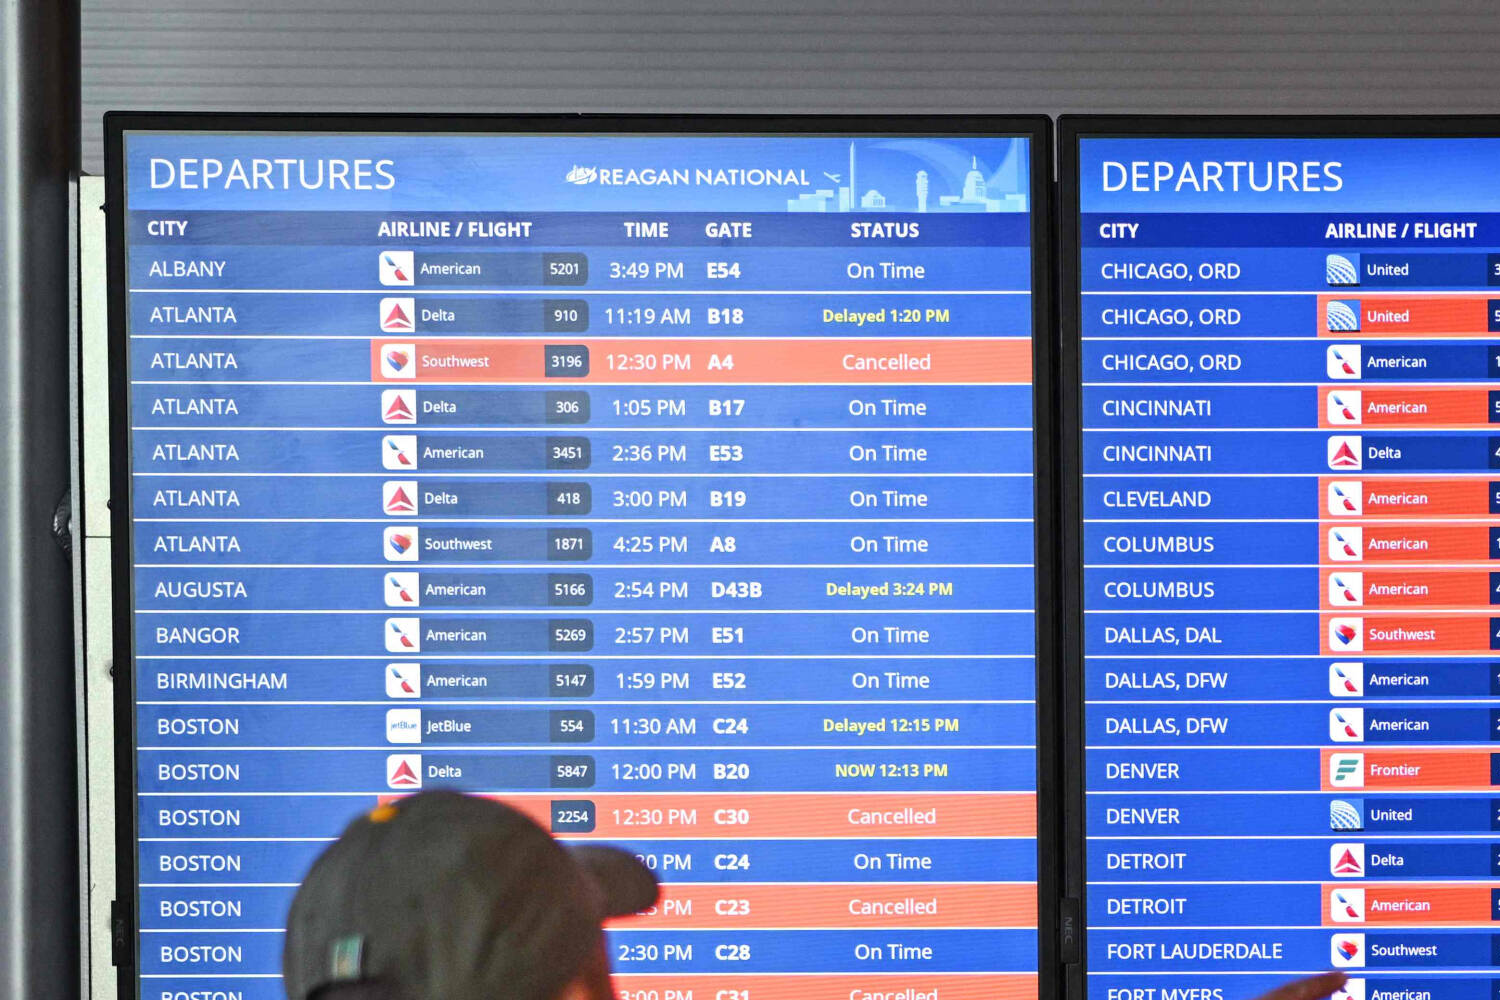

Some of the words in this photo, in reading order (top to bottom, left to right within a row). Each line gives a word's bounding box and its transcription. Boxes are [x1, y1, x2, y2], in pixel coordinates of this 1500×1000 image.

[150, 158, 396, 191] DEPARTURES
[599, 168, 690, 186] REAGAN
[695, 169, 810, 186] NATIONAL
[1103, 161, 1343, 192] DEPARTURES
[147, 220, 188, 236] CITY
[377, 221, 451, 238] AIRLINE
[455, 221, 464, 237] /
[468, 221, 533, 238] FLIGHT
[623, 221, 669, 238] TIME
[705, 222, 752, 238] GATE
[850, 222, 920, 238] STATUS
[1099, 222, 1140, 239] CITY
[1324, 222, 1397, 239] AIRLINE
[1400, 222, 1410, 239] /
[1414, 222, 1478, 239] FLIGHT
[148, 260, 226, 277] ALBANY
[420, 262, 481, 275] American
[550, 262, 579, 275] 5201
[609, 262, 650, 279] 3:49
[655, 262, 684, 279] PM
[706, 262, 742, 279] E54
[846, 262, 875, 279] On
[879, 262, 925, 279] Time
[1101, 262, 1193, 282] CHICAGO,
[1198, 262, 1241, 280] ORD
[1367, 263, 1409, 276] United
[150, 352, 238, 369] ATLANTA
[421, 354, 490, 368] Southwest
[551, 355, 583, 368] 3196
[607, 353, 657, 371] 12:30
[662, 353, 691, 371] PM
[707, 353, 735, 371] A4
[842, 353, 931, 371] Cancelled
[1102, 399, 1211, 417] CINCINNATI
[1367, 401, 1428, 414] American
[154, 581, 248, 598] AUGUSTA
[425, 583, 486, 596] American
[554, 583, 586, 596] 5166
[614, 581, 655, 599] 2:54
[659, 581, 688, 598] PM
[711, 581, 763, 598] D43B
[826, 581, 889, 600] Delayed
[892, 582, 926, 596] 3:24
[928, 582, 953, 596] PM
[158, 763, 240, 781] BOSTON
[428, 764, 462, 778] Delta
[557, 765, 588, 778] 5847
[611, 763, 663, 780] 12:00
[667, 763, 697, 780] PM
[713, 763, 750, 780] B20
[835, 763, 876, 778] NOW
[879, 763, 920, 777] 12:13
[923, 763, 948, 777] PM
[160, 945, 242, 963] BOSTON
[618, 944, 659, 961] 2:30
[663, 944, 693, 961] PM
[714, 944, 751, 961] C28
[854, 943, 883, 960] On
[886, 943, 933, 960] Time
[1107, 943, 1156, 960] FORT
[1161, 942, 1283, 960] LAUDERDALE
[1371, 943, 1438, 956] Southwest
